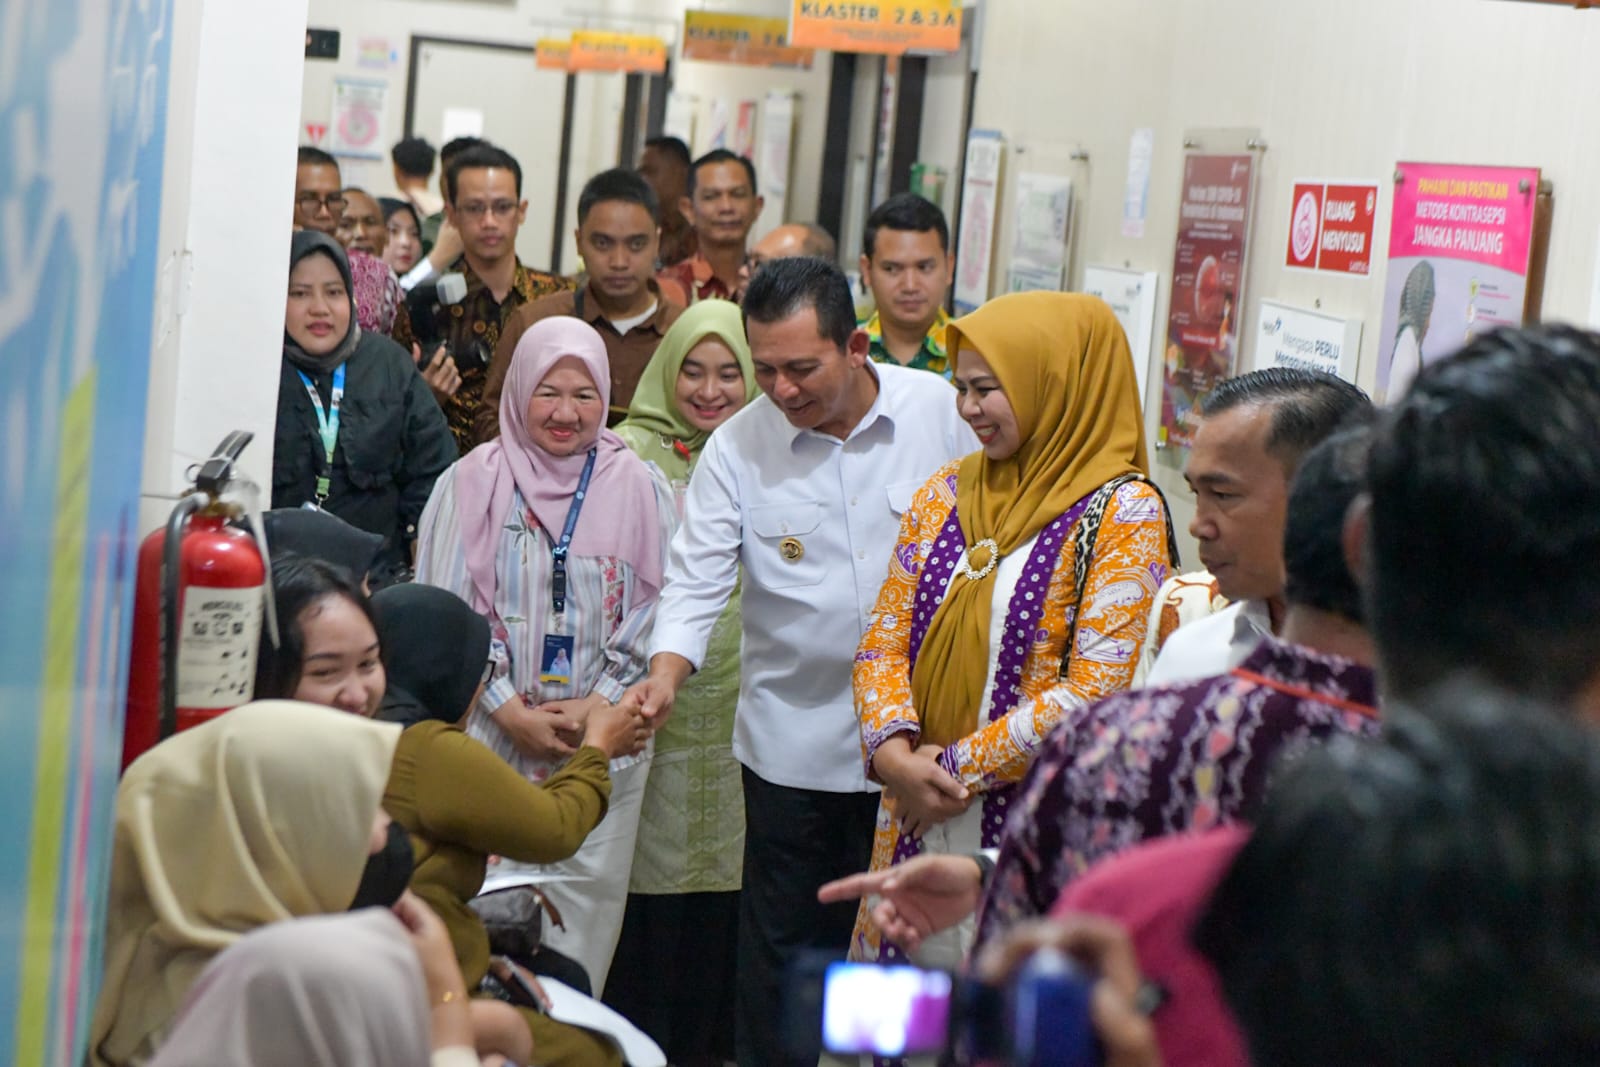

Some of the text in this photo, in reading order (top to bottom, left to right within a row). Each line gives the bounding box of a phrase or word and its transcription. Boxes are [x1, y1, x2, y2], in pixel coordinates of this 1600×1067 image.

[802, 3, 879, 19] KLASTER
[944, 12, 955, 26] A
[688, 26, 750, 42] KLASTER
[1418, 178, 1509, 199] PAHAMI DAN PASTIKAN
[1325, 200, 1356, 222] RUANG
[1415, 201, 1506, 225] METODE KONTRASEPSI
[1322, 229, 1366, 253] MENYUSUI
[1412, 224, 1504, 254] JANGKA PANJANG
[1314, 339, 1339, 360] PERLU
